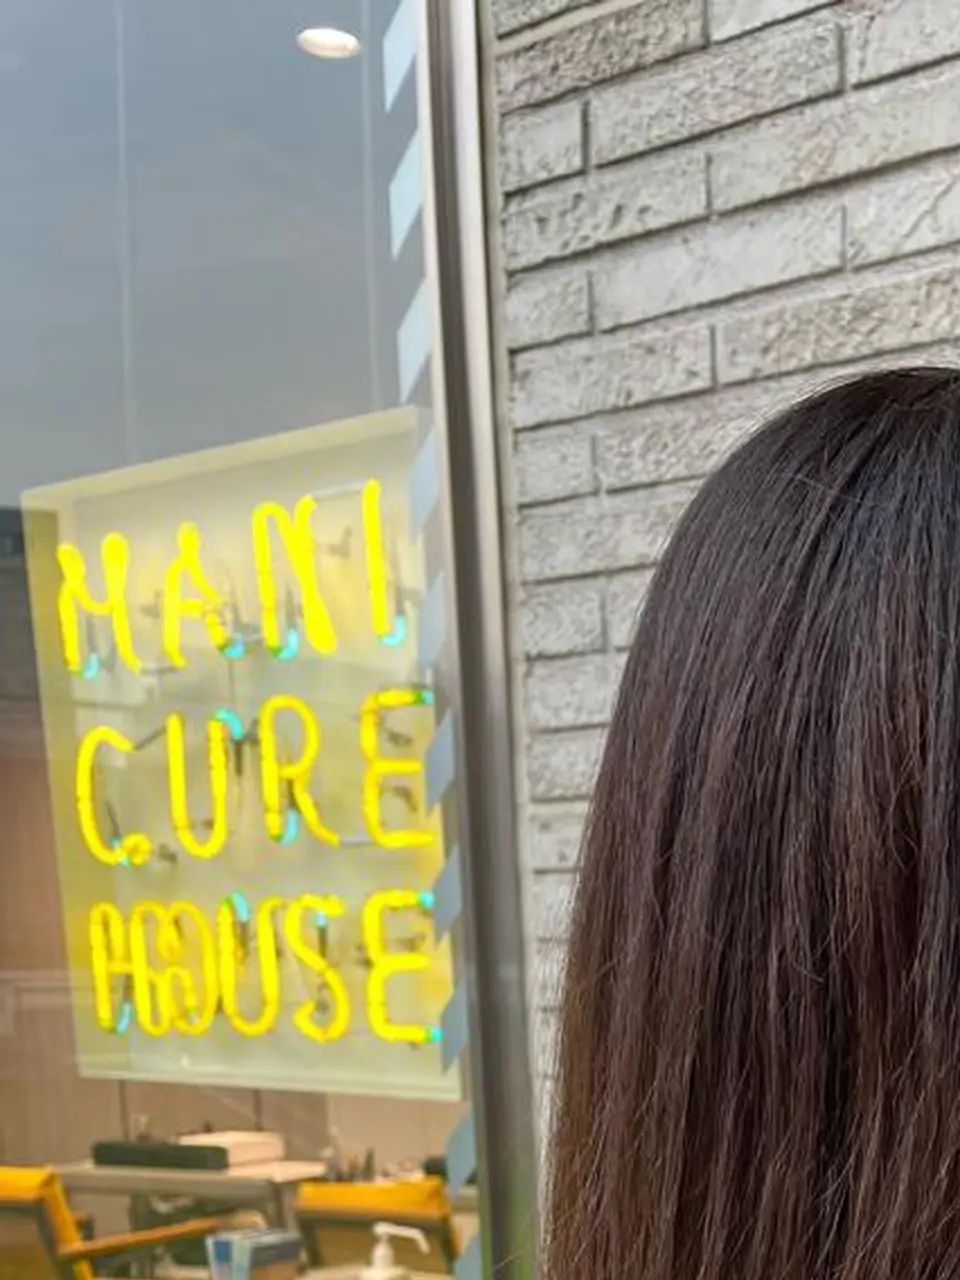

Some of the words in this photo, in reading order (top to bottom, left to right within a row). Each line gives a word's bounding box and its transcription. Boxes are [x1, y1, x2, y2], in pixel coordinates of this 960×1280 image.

[57, 478, 396, 674] MANI
[76, 692, 434, 865] CURE
[90, 889, 438, 1042] HOUSE
